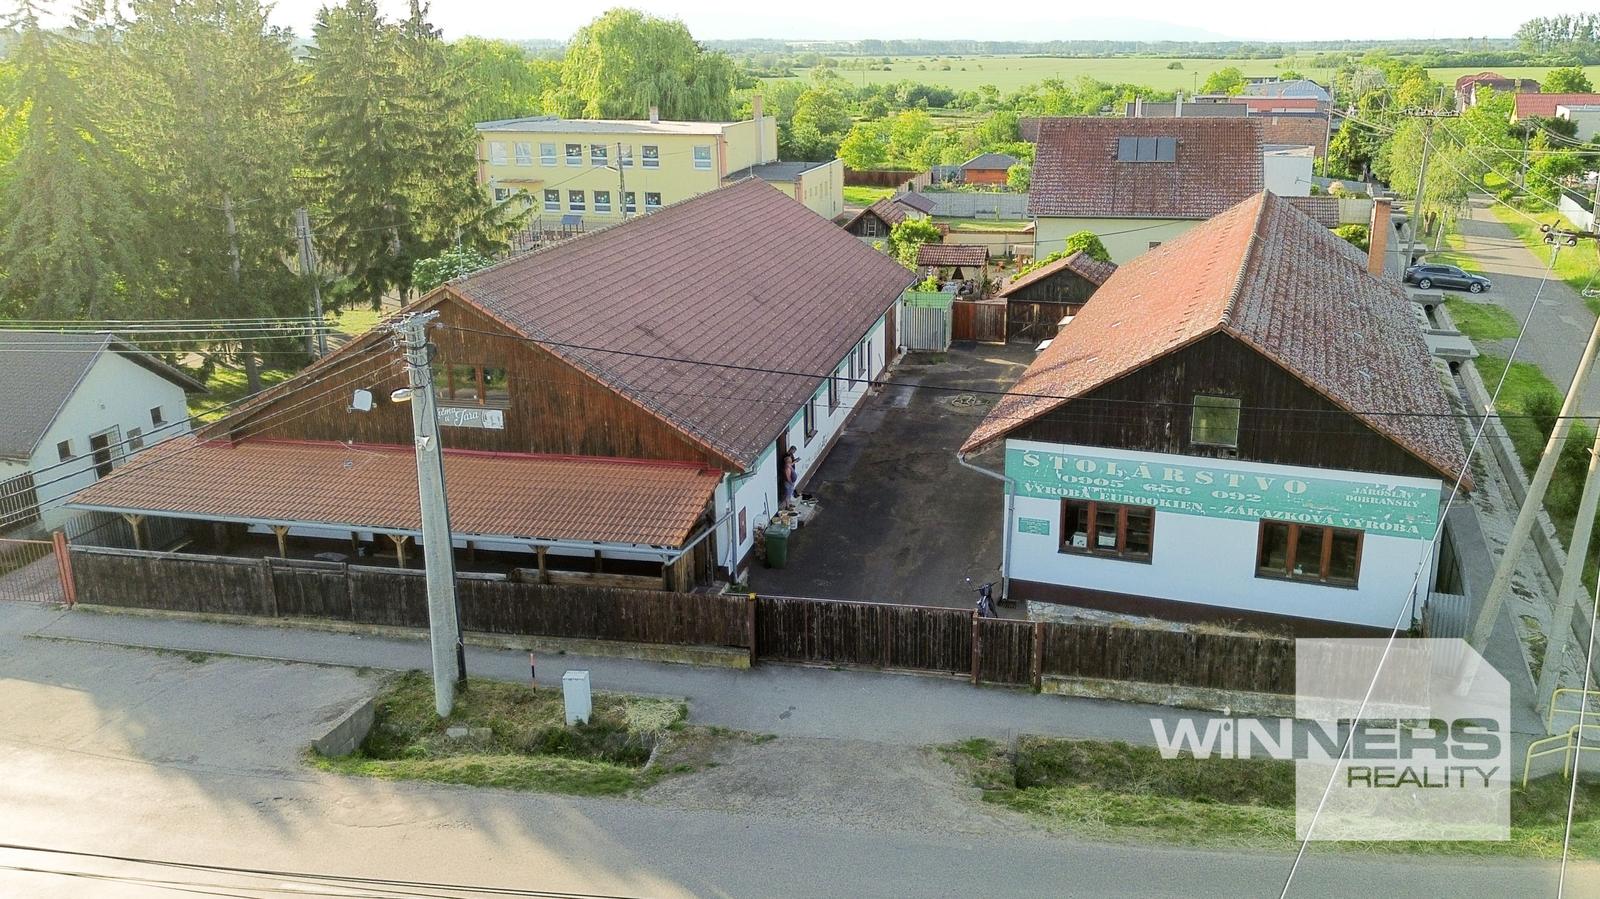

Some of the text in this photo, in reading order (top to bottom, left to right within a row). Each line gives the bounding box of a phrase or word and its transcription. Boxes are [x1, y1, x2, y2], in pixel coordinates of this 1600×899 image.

[1061, 475, 1262, 502] 0905 656 092
